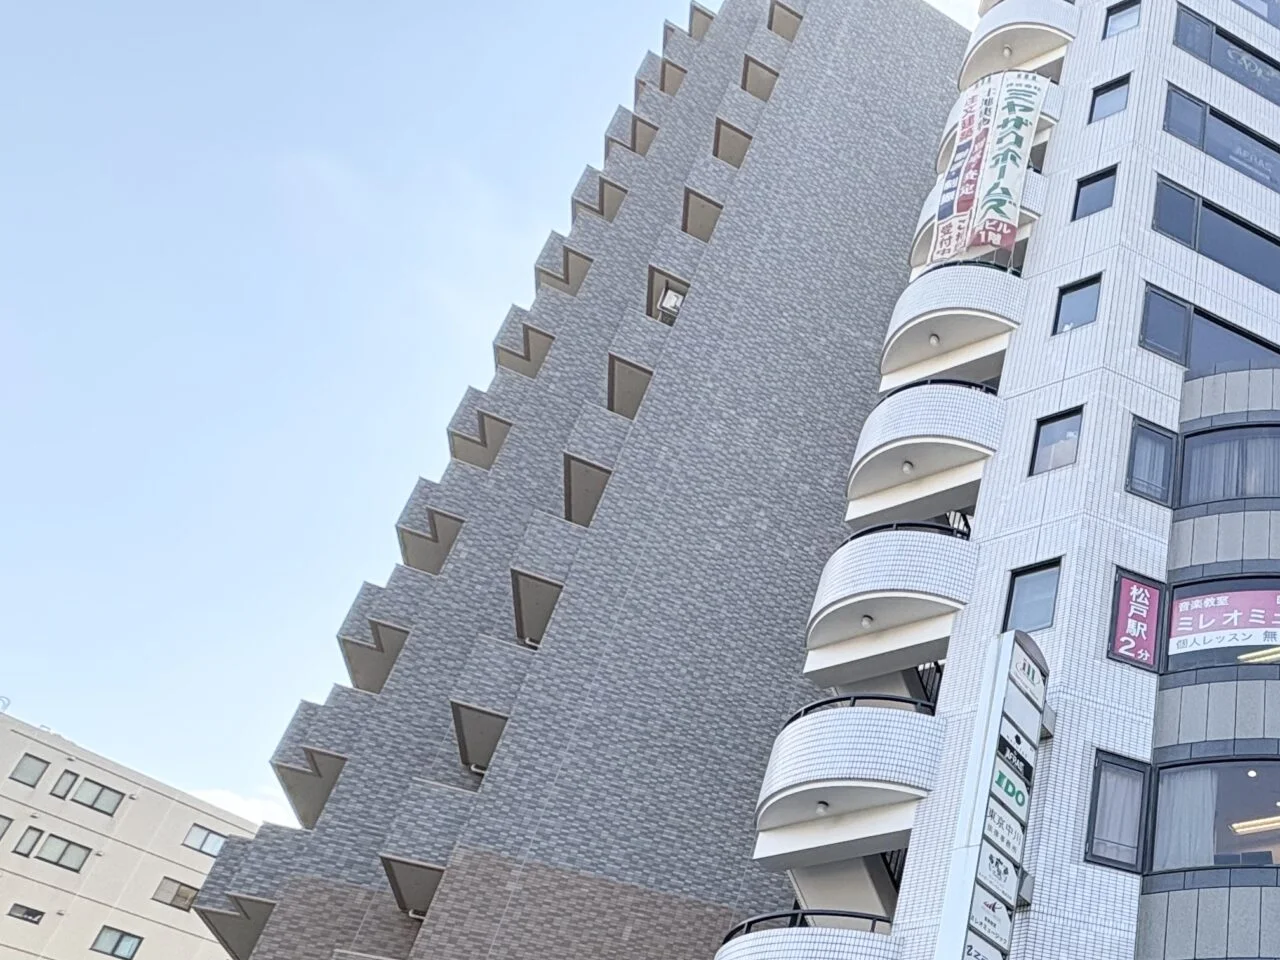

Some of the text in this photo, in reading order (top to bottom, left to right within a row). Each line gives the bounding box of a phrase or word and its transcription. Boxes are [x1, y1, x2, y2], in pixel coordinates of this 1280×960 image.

[1178, 595, 1230, 613] 音楽教室
[1176, 632, 1253, 650] 個人レッスン
[995, 769, 1026, 807] IDO
